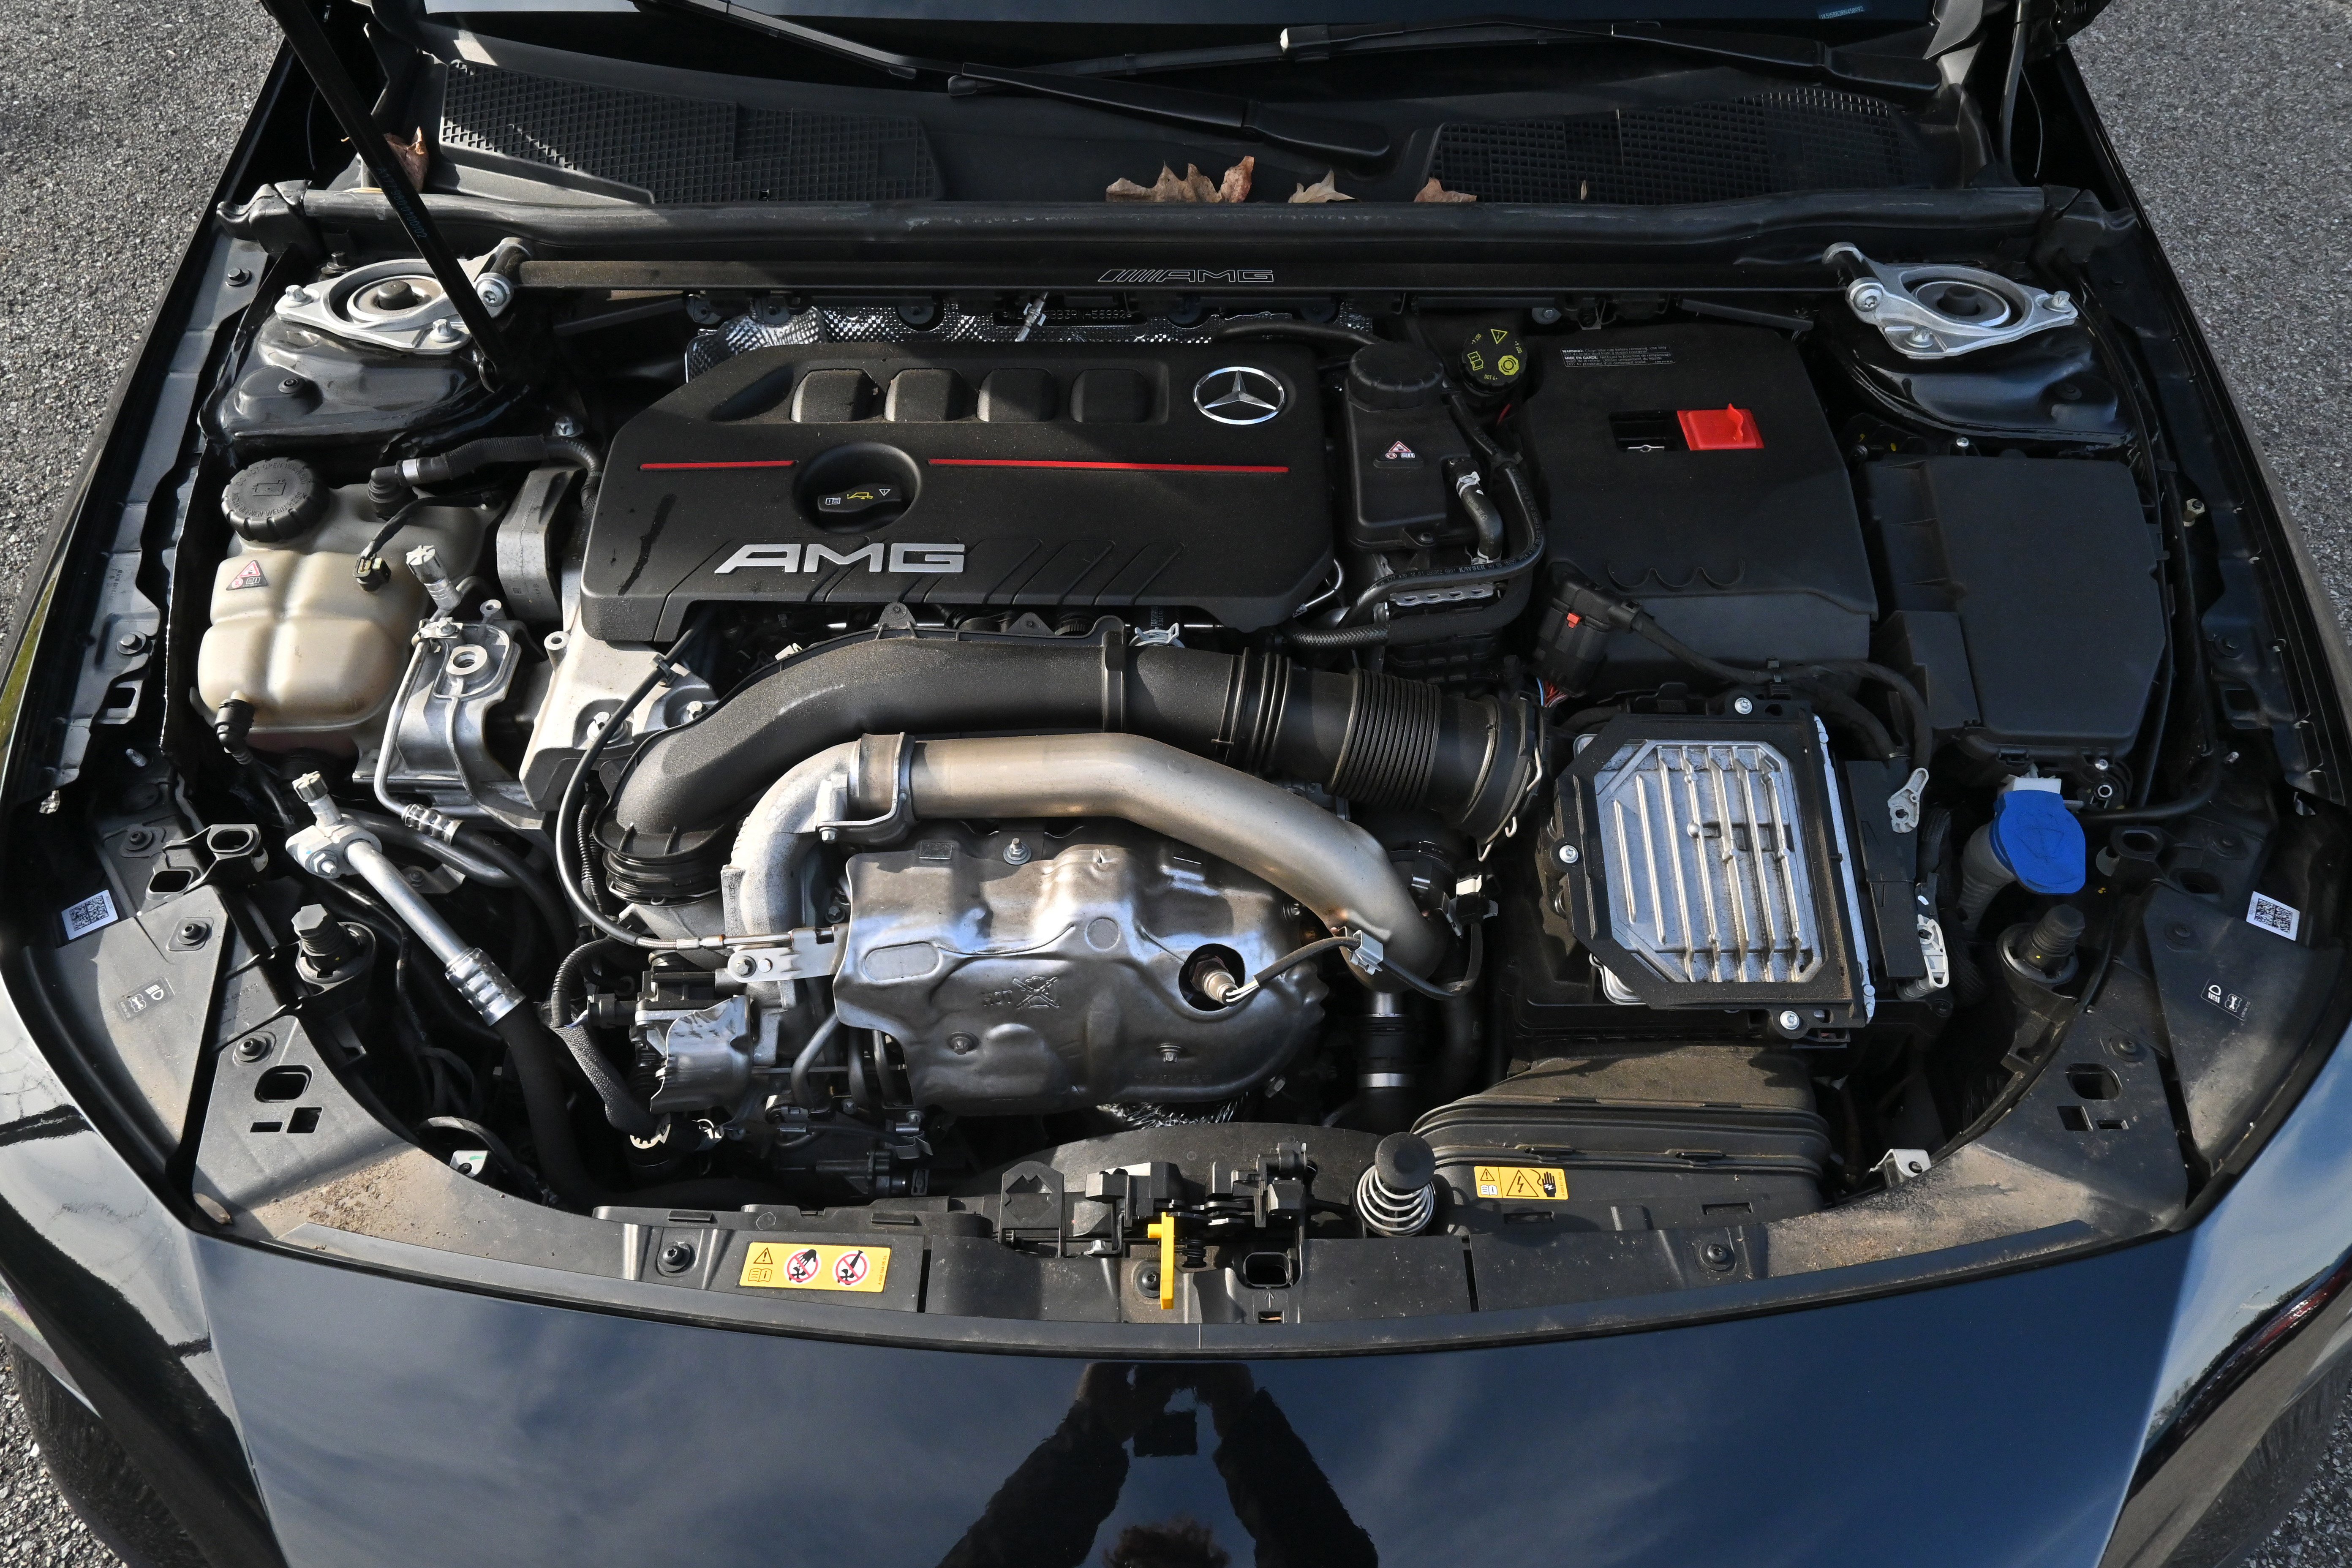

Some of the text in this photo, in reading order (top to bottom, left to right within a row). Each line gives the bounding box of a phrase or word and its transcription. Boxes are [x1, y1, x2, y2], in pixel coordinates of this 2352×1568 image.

[1156, 270, 1274, 282] AMG
[262, 462, 283, 470] OPEN
[265, 505, 288, 516] WENN
[714, 543, 965, 574] AMG
